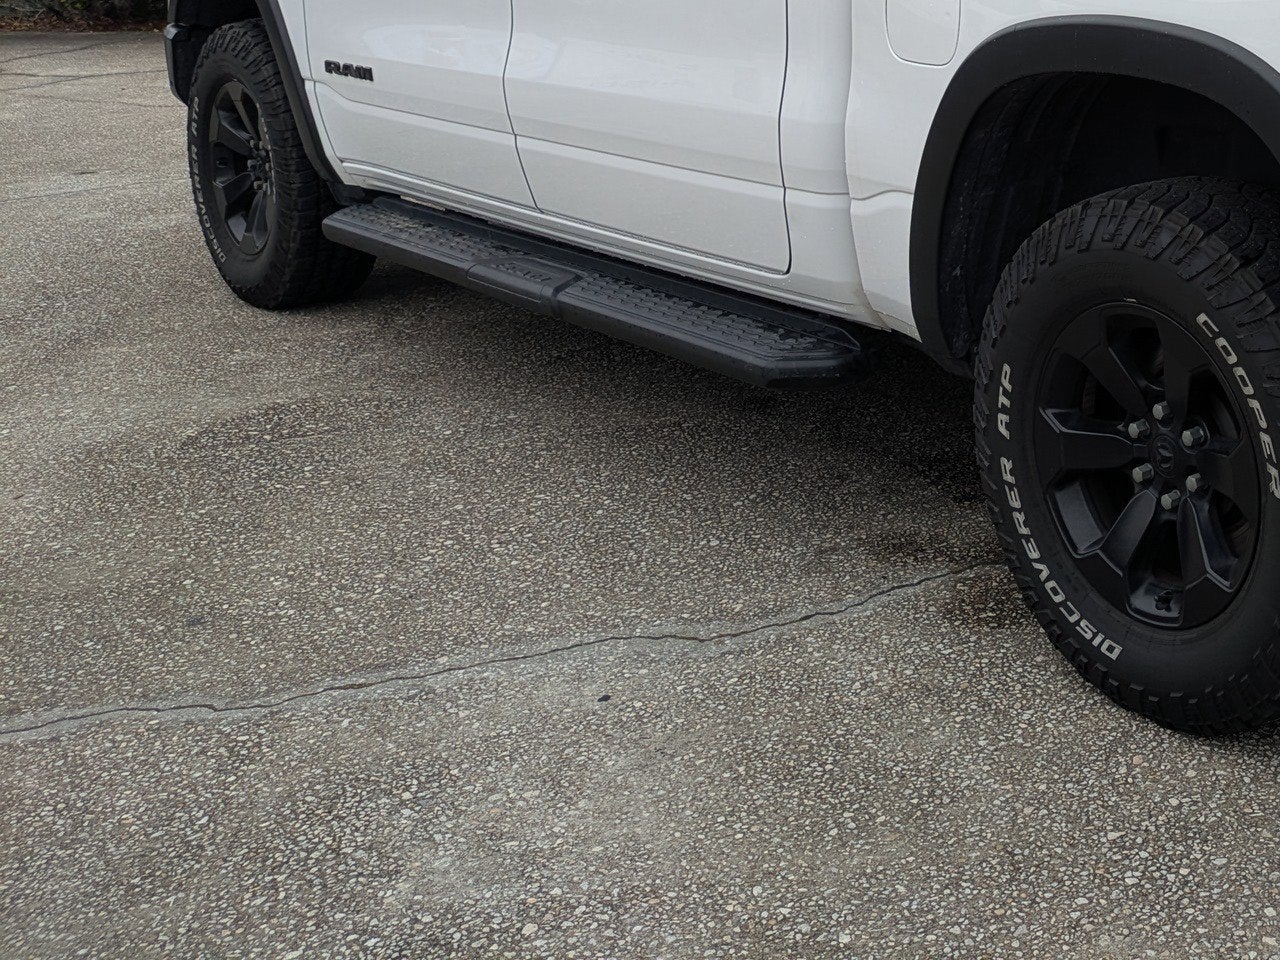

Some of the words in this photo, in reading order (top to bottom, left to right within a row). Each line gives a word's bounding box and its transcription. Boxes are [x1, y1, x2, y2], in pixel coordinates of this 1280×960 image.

[324, 59, 374, 82] RAM
[998, 362, 1015, 440] ATP
[1000, 456, 1123, 661] DISCOVERER
